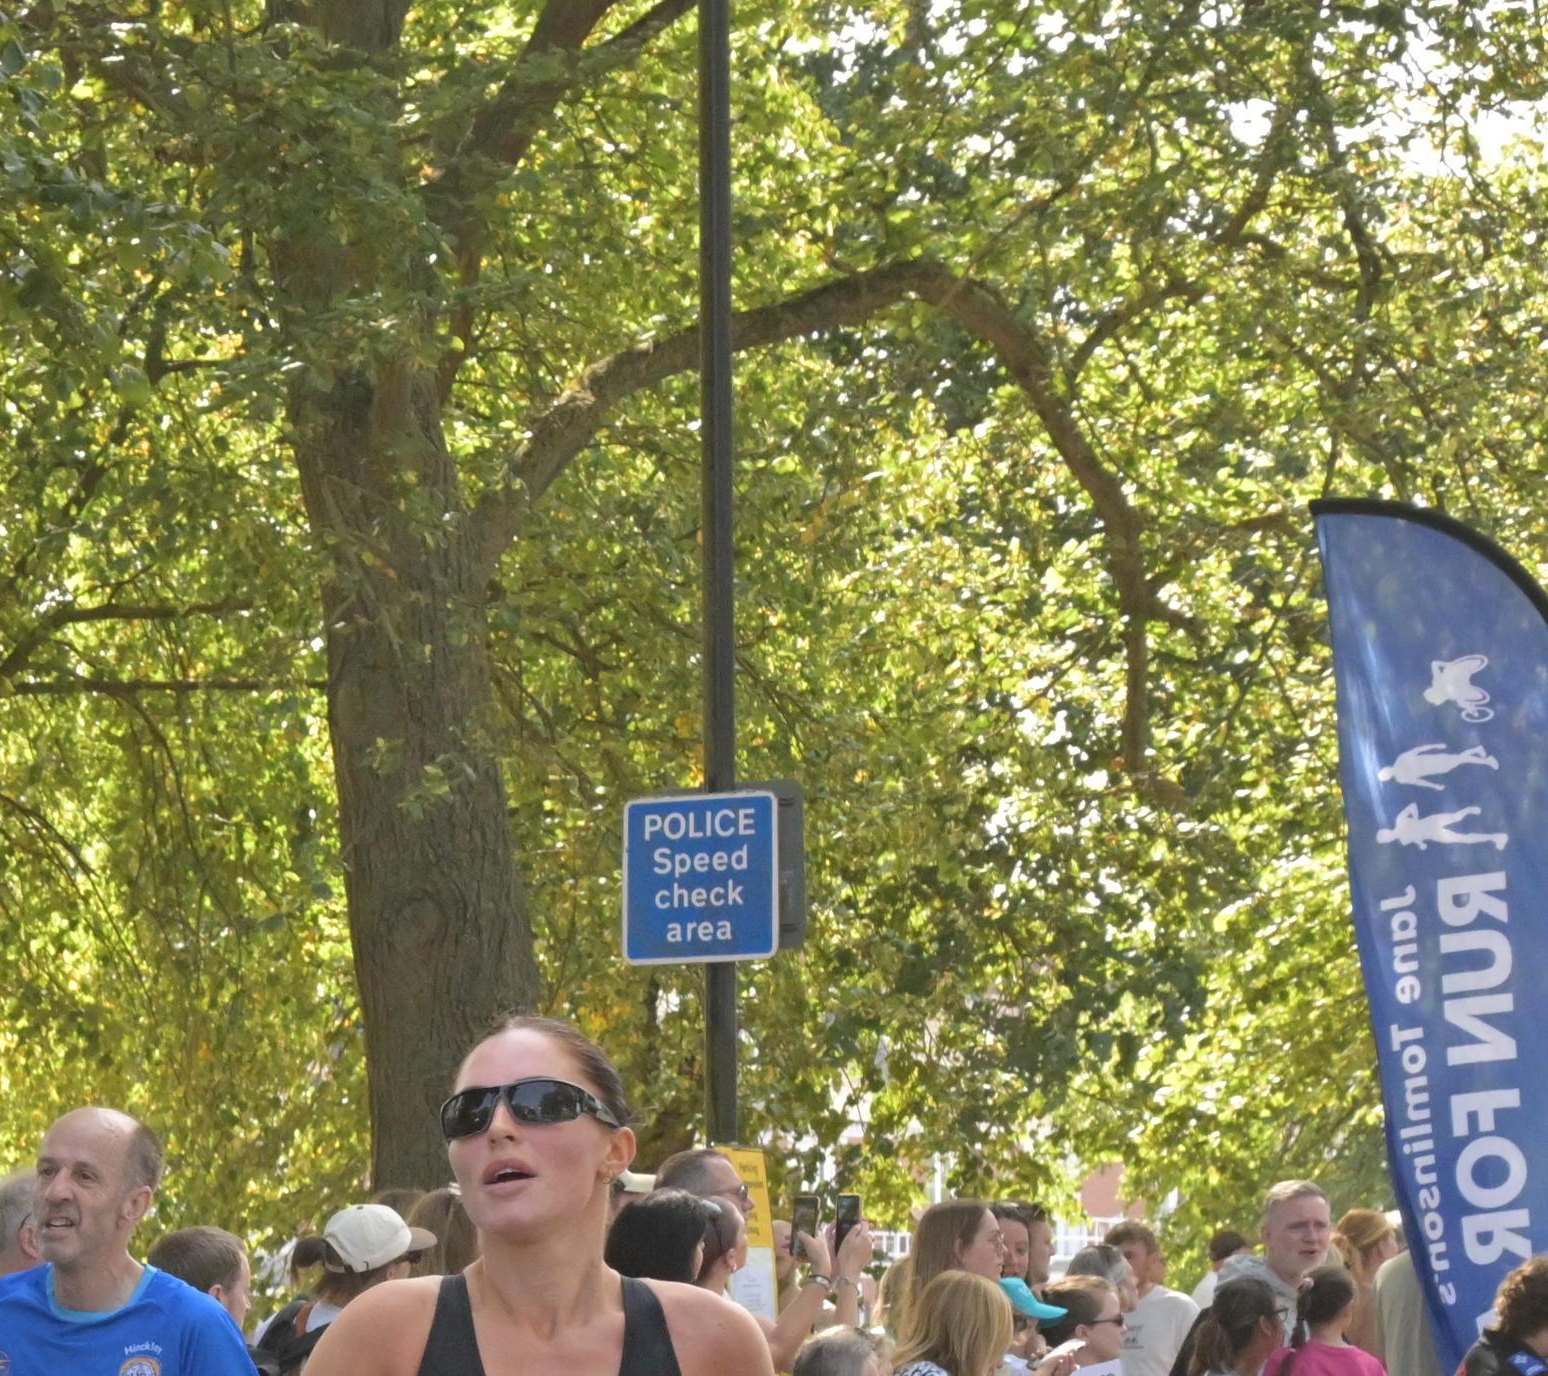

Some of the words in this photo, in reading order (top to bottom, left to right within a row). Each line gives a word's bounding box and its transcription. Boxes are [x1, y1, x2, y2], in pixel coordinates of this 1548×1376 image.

[644, 808, 756, 841] POLICE
[653, 843, 748, 878] Speed
[655, 879, 744, 909] check
[666, 920, 732, 943] area
[124, 1341, 163, 1355] Hinckley
